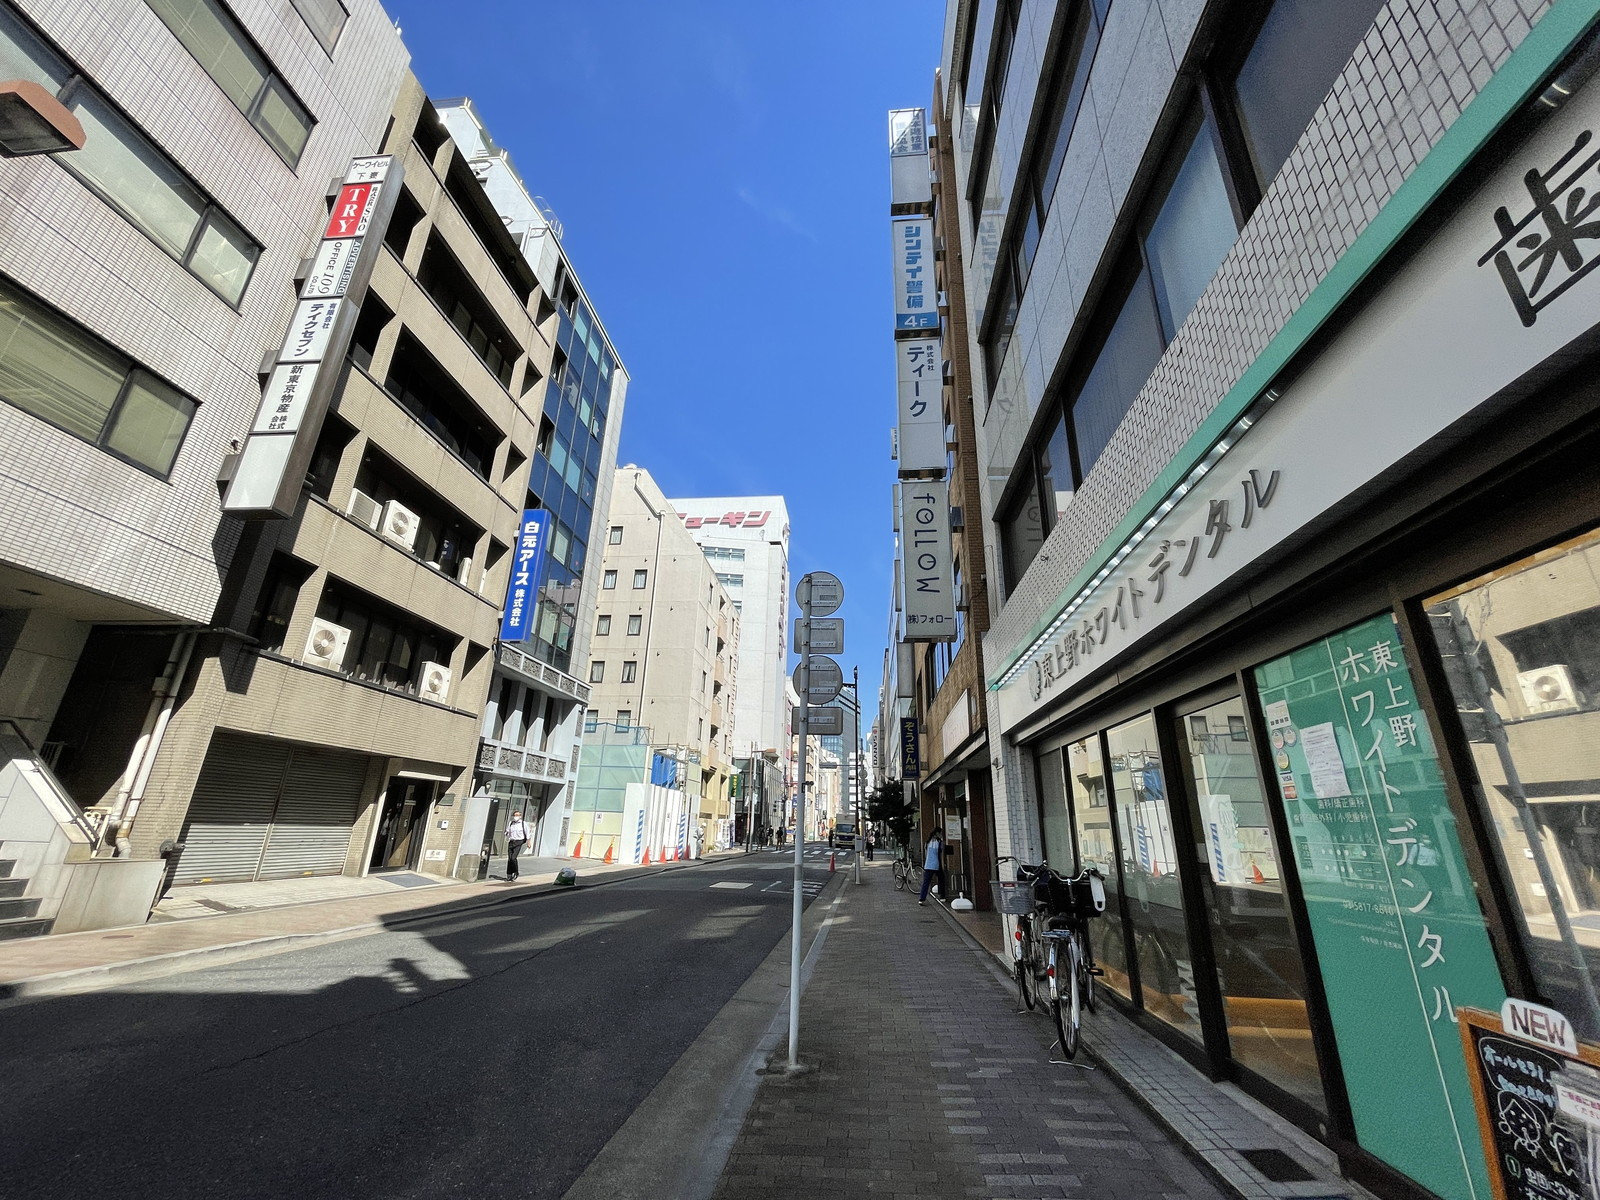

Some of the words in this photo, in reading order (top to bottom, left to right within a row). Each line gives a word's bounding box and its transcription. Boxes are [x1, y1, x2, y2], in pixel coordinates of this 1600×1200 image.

[352, 160, 389, 170] ケーワイビル
[338, 187, 366, 234] TRY
[326, 241, 343, 271] OFFICE
[337, 241, 361, 294] ADVERTISING
[318, 272, 335, 295] 109
[294, 303, 325, 357] テイクセブン
[322, 302, 338, 330] 有限会社
[926, 344, 935, 371] 株式会社
[276, 364, 304, 414] 新東京物産
[907, 346, 927, 418] ティーク
[515, 521, 540, 586] 白元アース
[1042, 469, 1280, 689] 東上野ホワイトデンタル
[509, 588, 526, 627] 株式会社
[1367, 639, 1418, 748] 東上野
[904, 721, 916, 765] ぞうさん
[1340, 646, 1459, 1024] ホワイトデンタル
[1509, 1003, 1567, 1048] NEW
